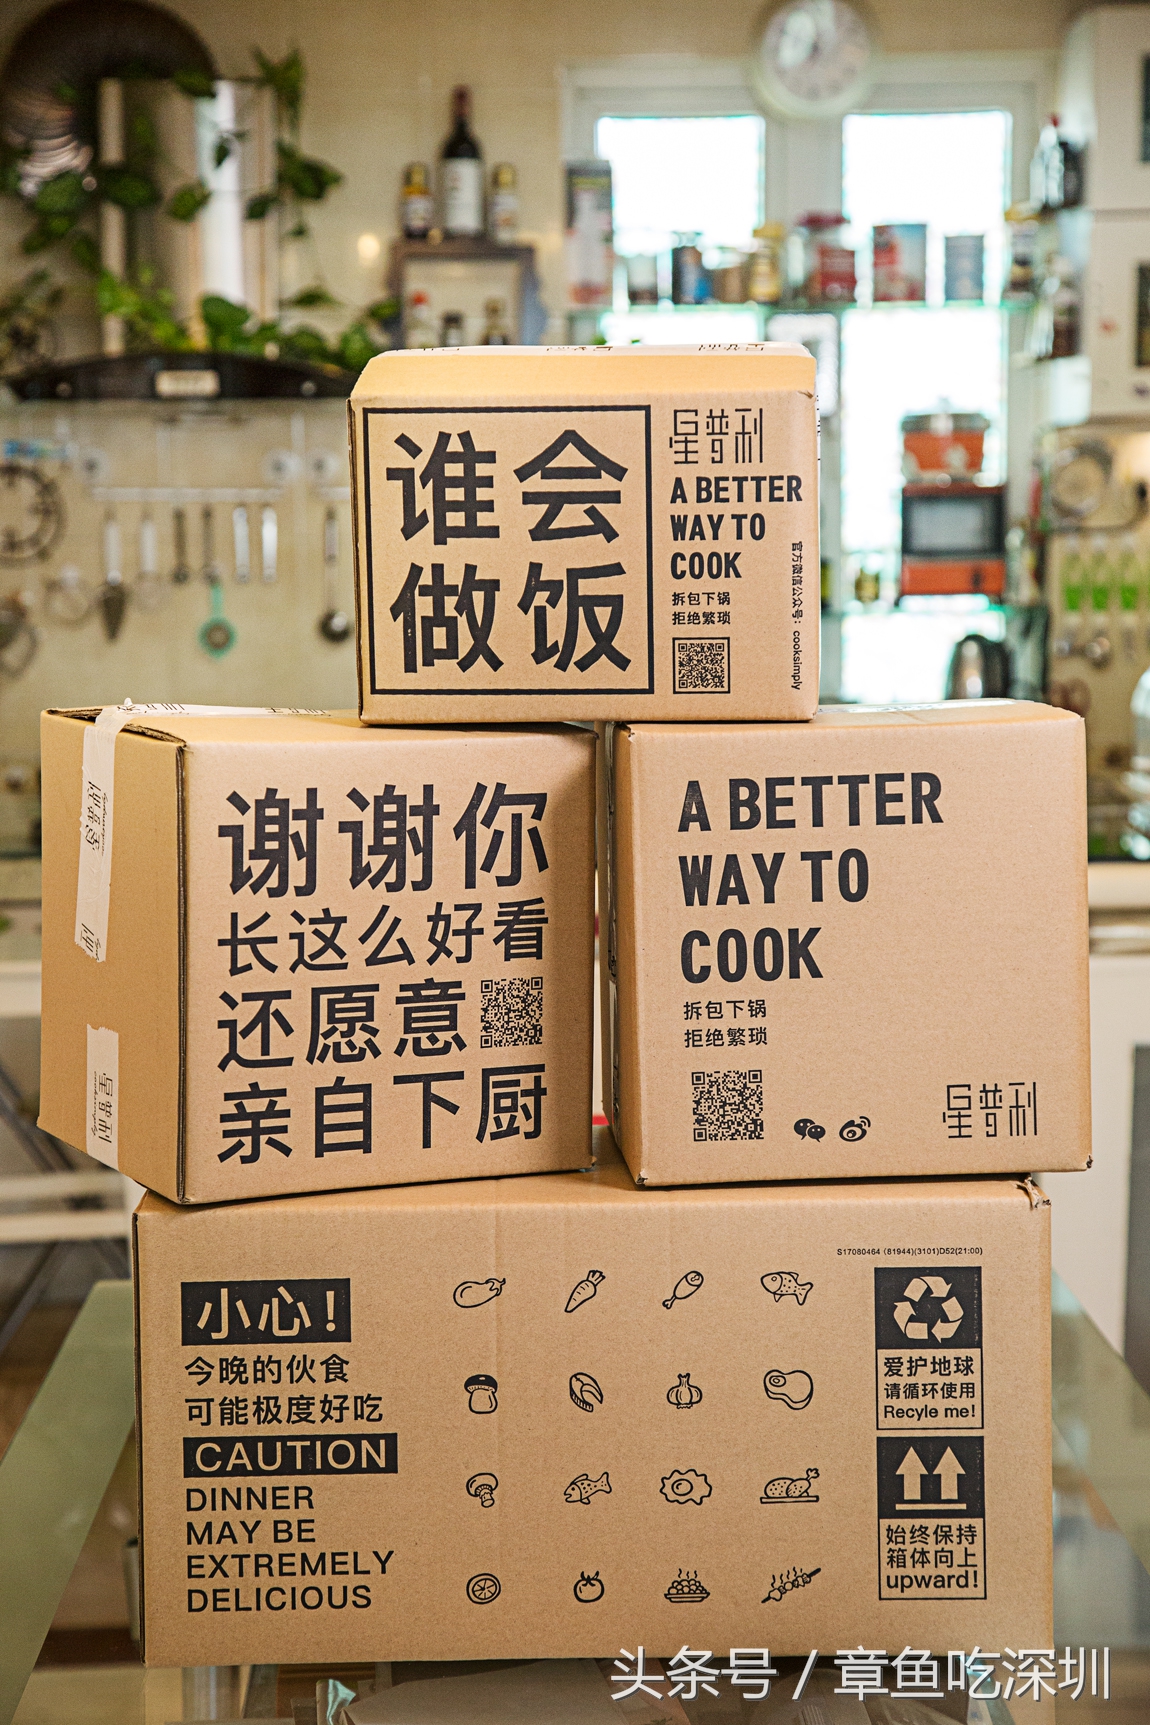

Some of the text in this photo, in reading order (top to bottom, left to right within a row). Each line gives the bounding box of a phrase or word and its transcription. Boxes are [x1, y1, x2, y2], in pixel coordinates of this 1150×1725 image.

[669, 408, 763, 464] 星普利
[386, 430, 628, 545] 谁会
[670, 475, 802, 504] A BETTER
[670, 513, 765, 541] WAY TO
[671, 552, 742, 579] COOK
[672, 592, 730, 606] 拆包下锅
[390, 562, 631, 673] 做饭
[672, 611, 730, 625] 拒绝繁琐
[791, 631, 802, 690] cooksimply
[678, 772, 943, 832] A BETTER
[217, 782, 550, 898] 谢谢你
[679, 849, 868, 906] WAY TO
[217, 897, 549, 977] 长这么好看
[681, 927, 823, 983] COOK
[684, 1000, 766, 1020] 拆包下锅
[217, 977, 467, 1073] 还愿意
[685, 1027, 767, 1048] 拒绝繁琐
[217, 1063, 548, 1165] 亲自下厨
[943, 1082, 1037, 1138] 星普利
[836, 1248, 881, 1256] S17080464
[185, 1354, 349, 1386] 今晚的伙食
[884, 1356, 974, 1377] 爱护地球
[884, 1382, 975, 1399] 请循环使用
[185, 1393, 383, 1426] 可能极度好吃
[884, 1405, 975, 1421] Recyle me!
[196, 1440, 385, 1471] CAUTION
[187, 1486, 314, 1512] DINNER
[187, 1519, 315, 1545] MAY BE
[886, 1524, 977, 1545] 始终保持
[187, 1551, 394, 1579] EXTREMELY
[886, 1547, 978, 1569] 箱体向上
[886, 1569, 979, 1590] upward!
[188, 1585, 371, 1612] DELICIOUS
